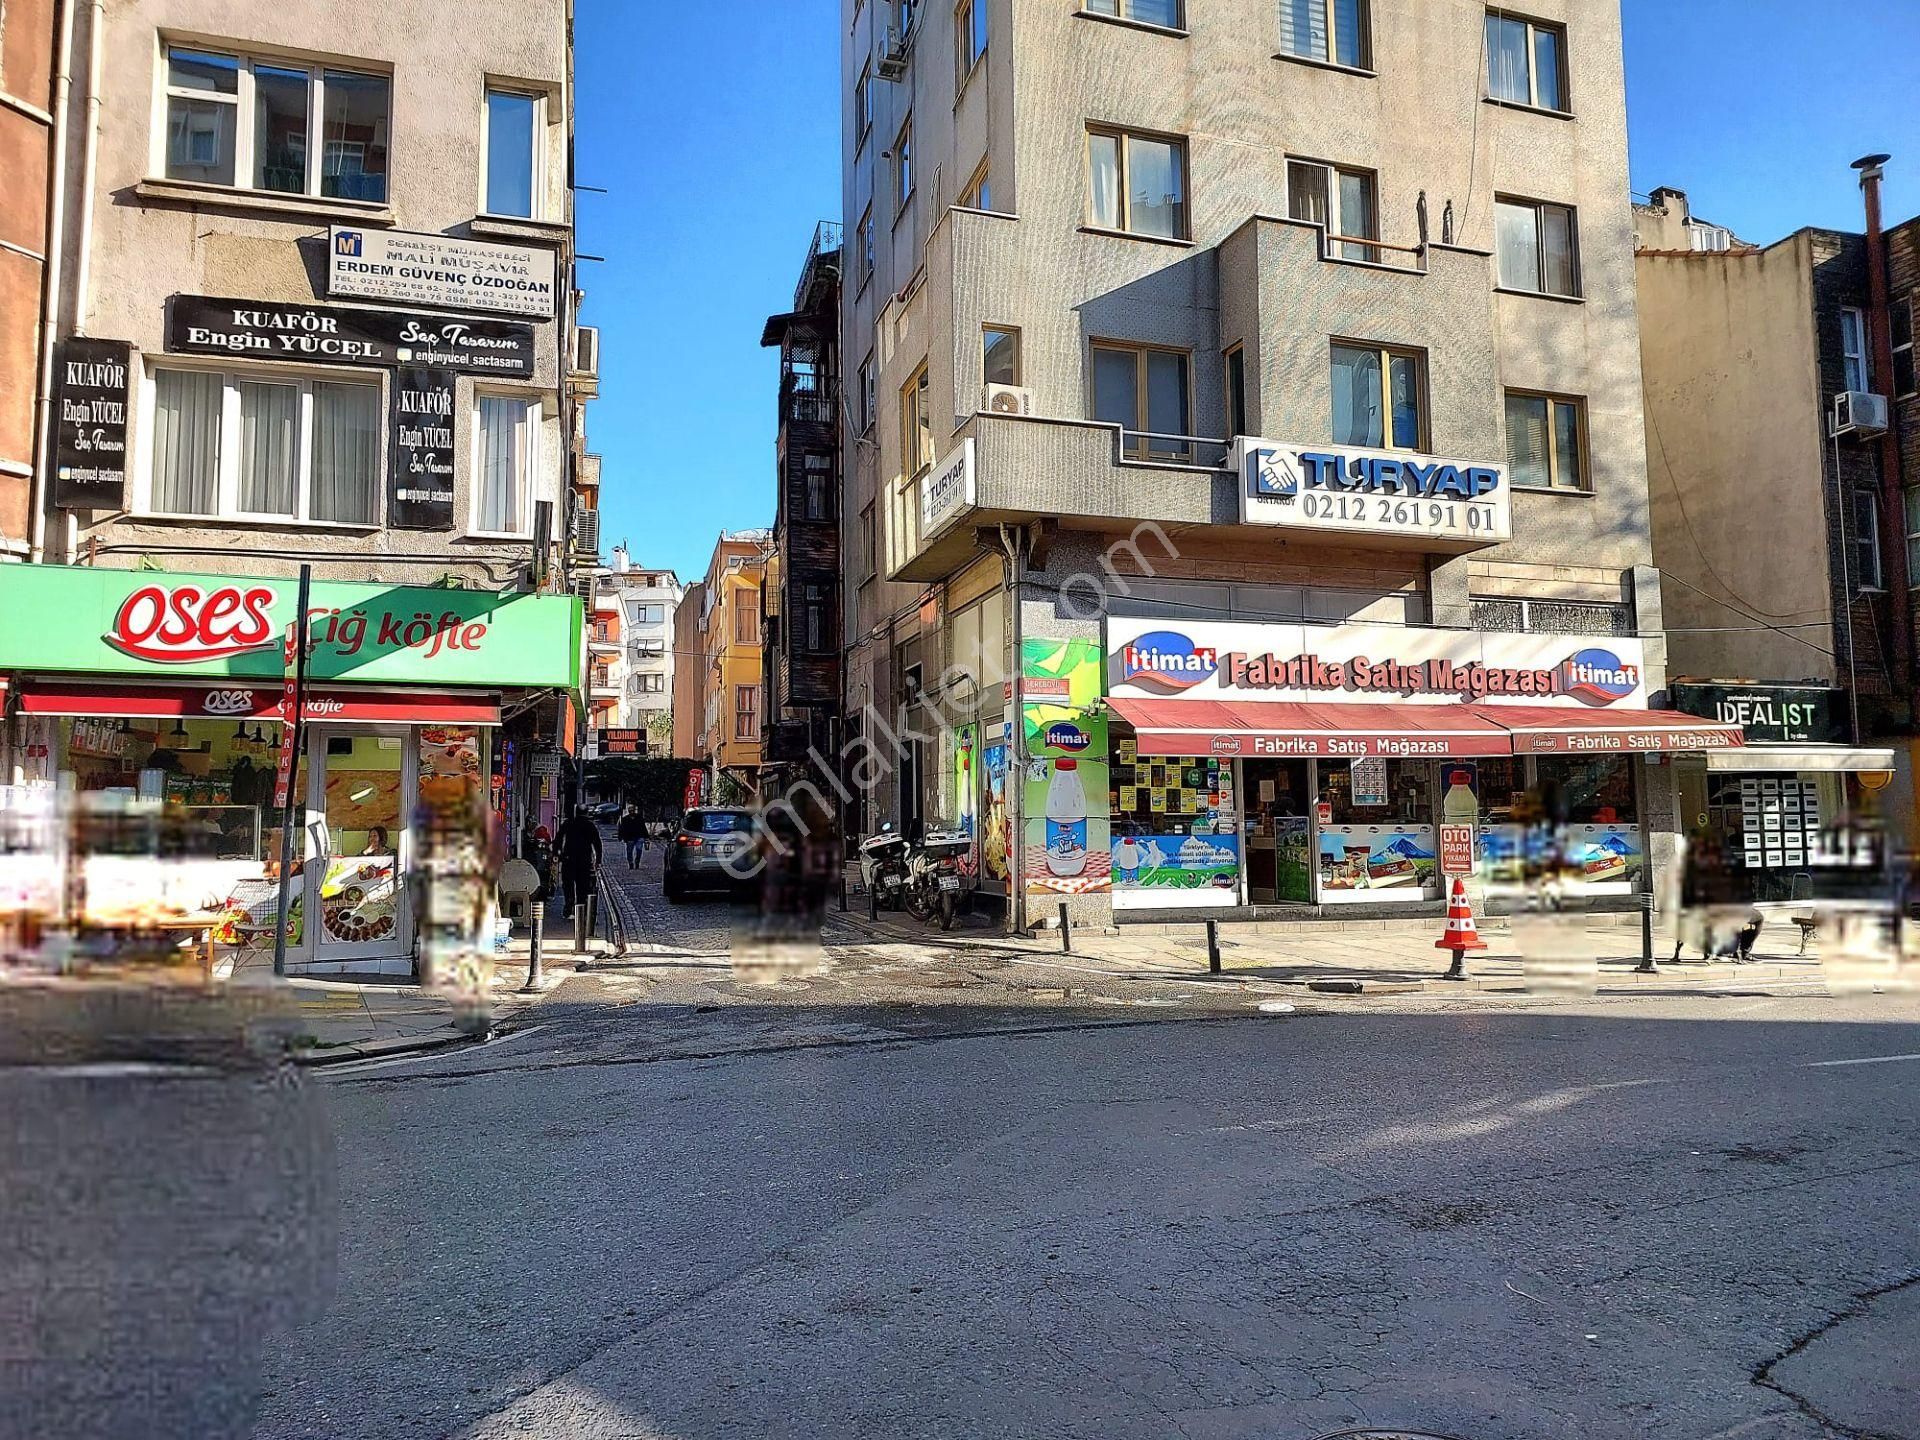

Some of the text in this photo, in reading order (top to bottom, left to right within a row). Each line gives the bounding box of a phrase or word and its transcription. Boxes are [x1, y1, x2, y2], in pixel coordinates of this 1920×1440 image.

[334, 283, 360, 292] FAX:
[363, 287, 389, 295] 0212
[337, 261, 549, 293] ERDEM GÜVENÇ ÖZDOĞAN
[360, 278, 385, 286] 0212
[232, 309, 338, 334] KUAFÖR
[187, 327, 382, 358] Engin YÜCEL
[400, 321, 519, 350] Saç Tasarım
[66, 358, 124, 388] KUAFÖR
[63, 397, 124, 427] Engin YÜCEL
[401, 387, 452, 415] KUAFÖR
[75, 428, 91, 452] Saç
[399, 423, 452, 451] Engin YÜCEL
[930, 458, 964, 501] TURYAP
[1301, 451, 1500, 498] TURYAP
[1303, 494, 1495, 531] 0212 261 91 01
[377, 611, 487, 658] köfte
[1131, 647, 1214, 672] itimat
[1229, 651, 1558, 699] Fabrika Satış Mağazası
[1571, 661, 1636, 686] itimat
[306, 698, 344, 715] köfte
[1716, 702, 1815, 726] IDEALIST
[1046, 732, 1088, 744] itimat
[1212, 740, 1240, 749] itimat
[1254, 738, 1449, 755] Fabrika Satış Mağazası
[1567, 733, 1729, 750] Fabrika Satış Mağazası
[1443, 829, 1470, 842] OTO
[1443, 843, 1470, 853] PARK
